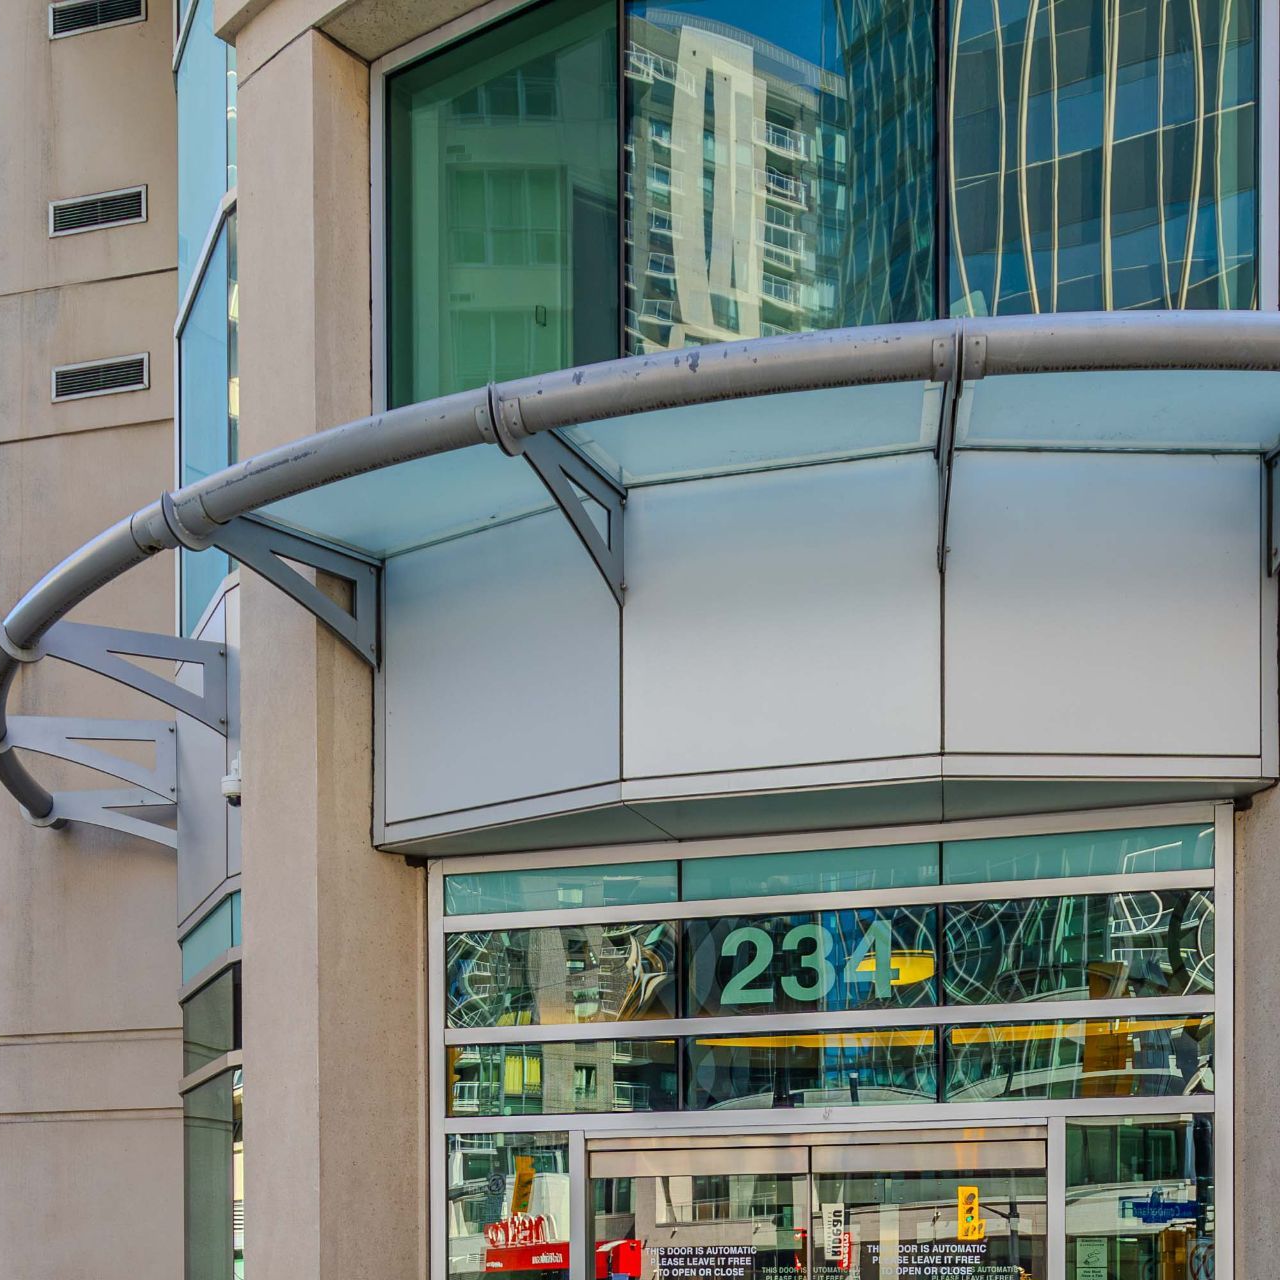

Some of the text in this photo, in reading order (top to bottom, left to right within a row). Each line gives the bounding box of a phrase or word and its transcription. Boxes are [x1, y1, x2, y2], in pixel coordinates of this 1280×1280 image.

[720, 919, 900, 1005] 234
[645, 1246, 757, 1255] THIS DOOR IS AUTOMATIC
[920, 1244, 930, 1253] IS
[932, 1244, 987, 1253] AUTOMATIC
[650, 1257, 752, 1266] PLEASE LEAVE IT FREE
[911, 1256, 942, 1264] LEAVE
[943, 1256, 953, 1264] IT
[955, 1256, 981, 1264] FREE
[659, 1268, 745, 1277] TO OPEN OR CLOSE
[896, 1267, 921, 1275] OPEN
[923, 1267, 938, 1275] OR
[940, 1266, 973, 1275] CLOSE
